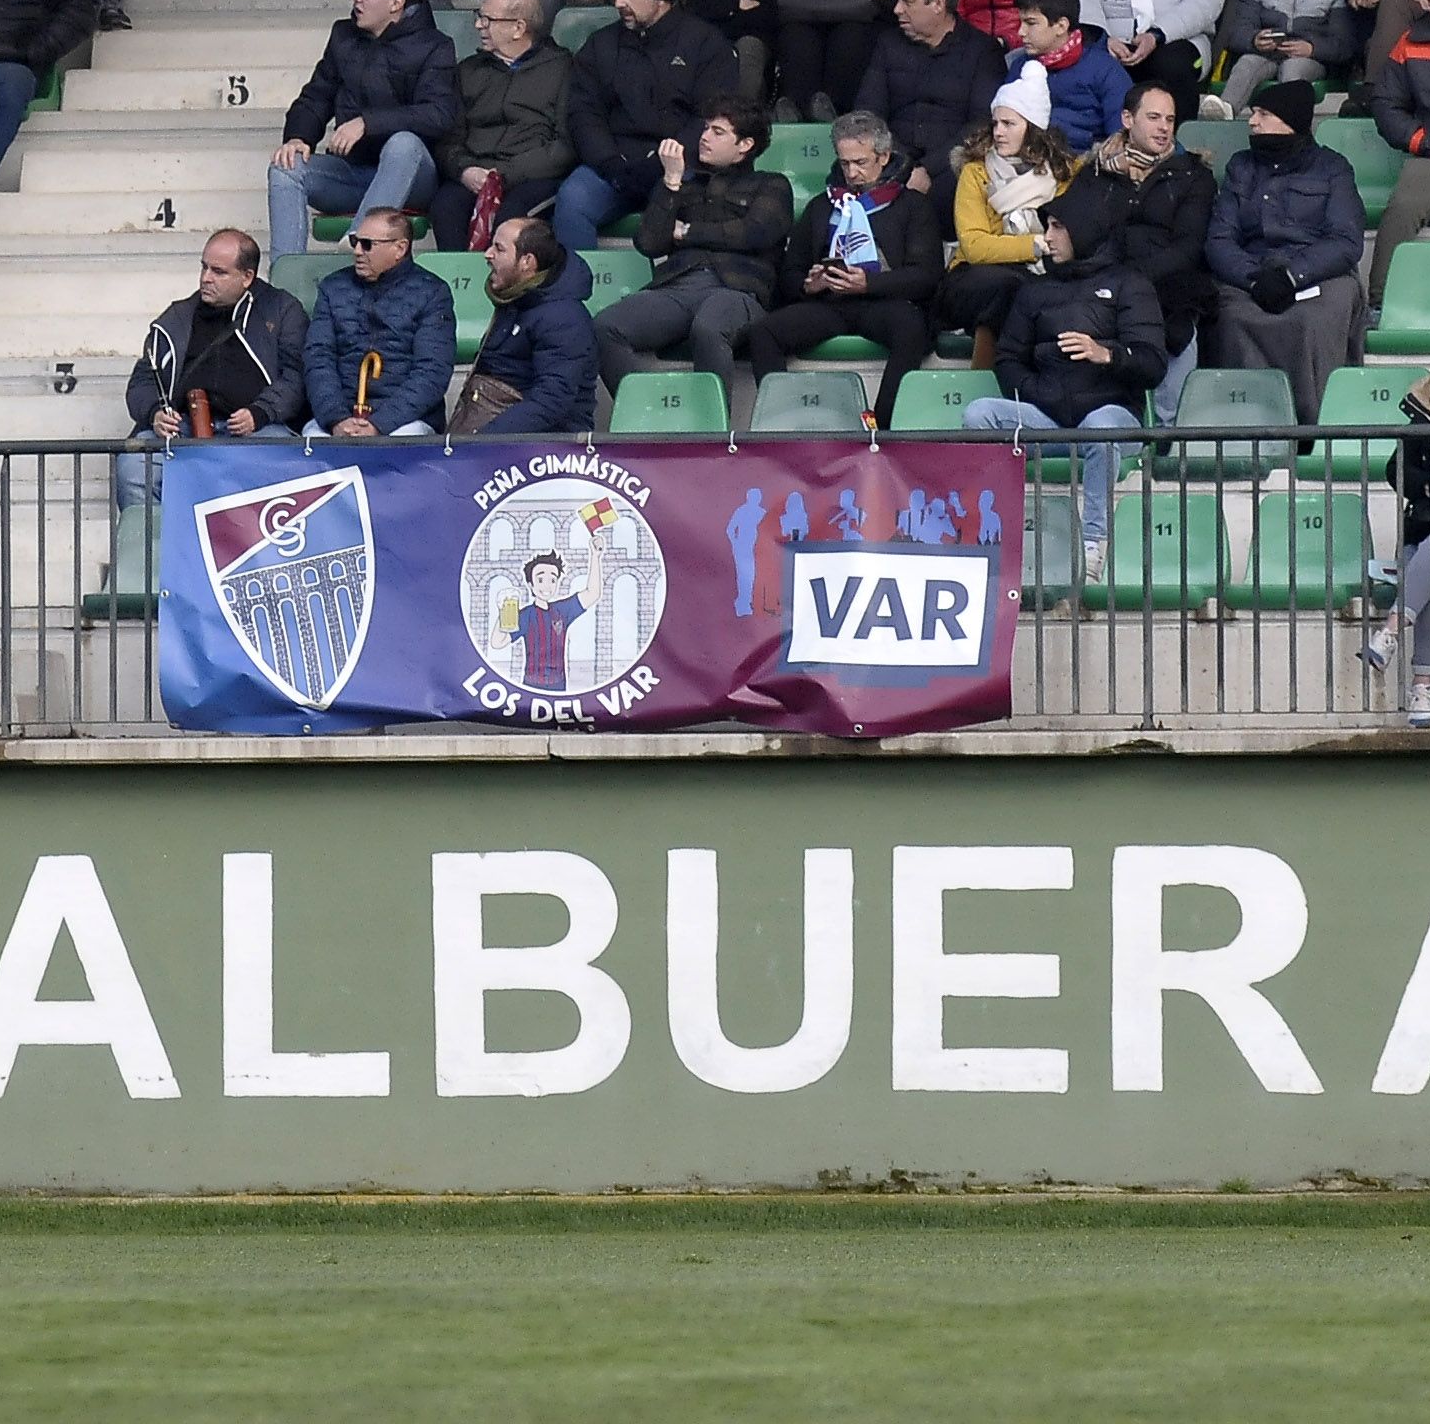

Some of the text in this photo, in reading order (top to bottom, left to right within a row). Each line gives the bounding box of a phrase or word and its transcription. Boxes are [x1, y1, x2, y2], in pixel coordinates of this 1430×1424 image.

[226, 75, 251, 106] 5
[802, 144, 820, 158] 15
[149, 198, 177, 229] 4
[452, 276, 472, 290] 17
[661, 395, 681, 408] 15
[800, 394, 820, 407] 14
[942, 392, 962, 406] 13
[1228, 390, 1247, 404] 11
[1371, 389, 1390, 402] 10
[473, 453, 653, 511] PEÑA GIMNÁSTICA
[1154, 523, 1173, 537] 11
[1302, 516, 1323, 530] 10
[809, 575, 970, 641] VAR
[462, 665, 661, 724] LOS DEL VAR
